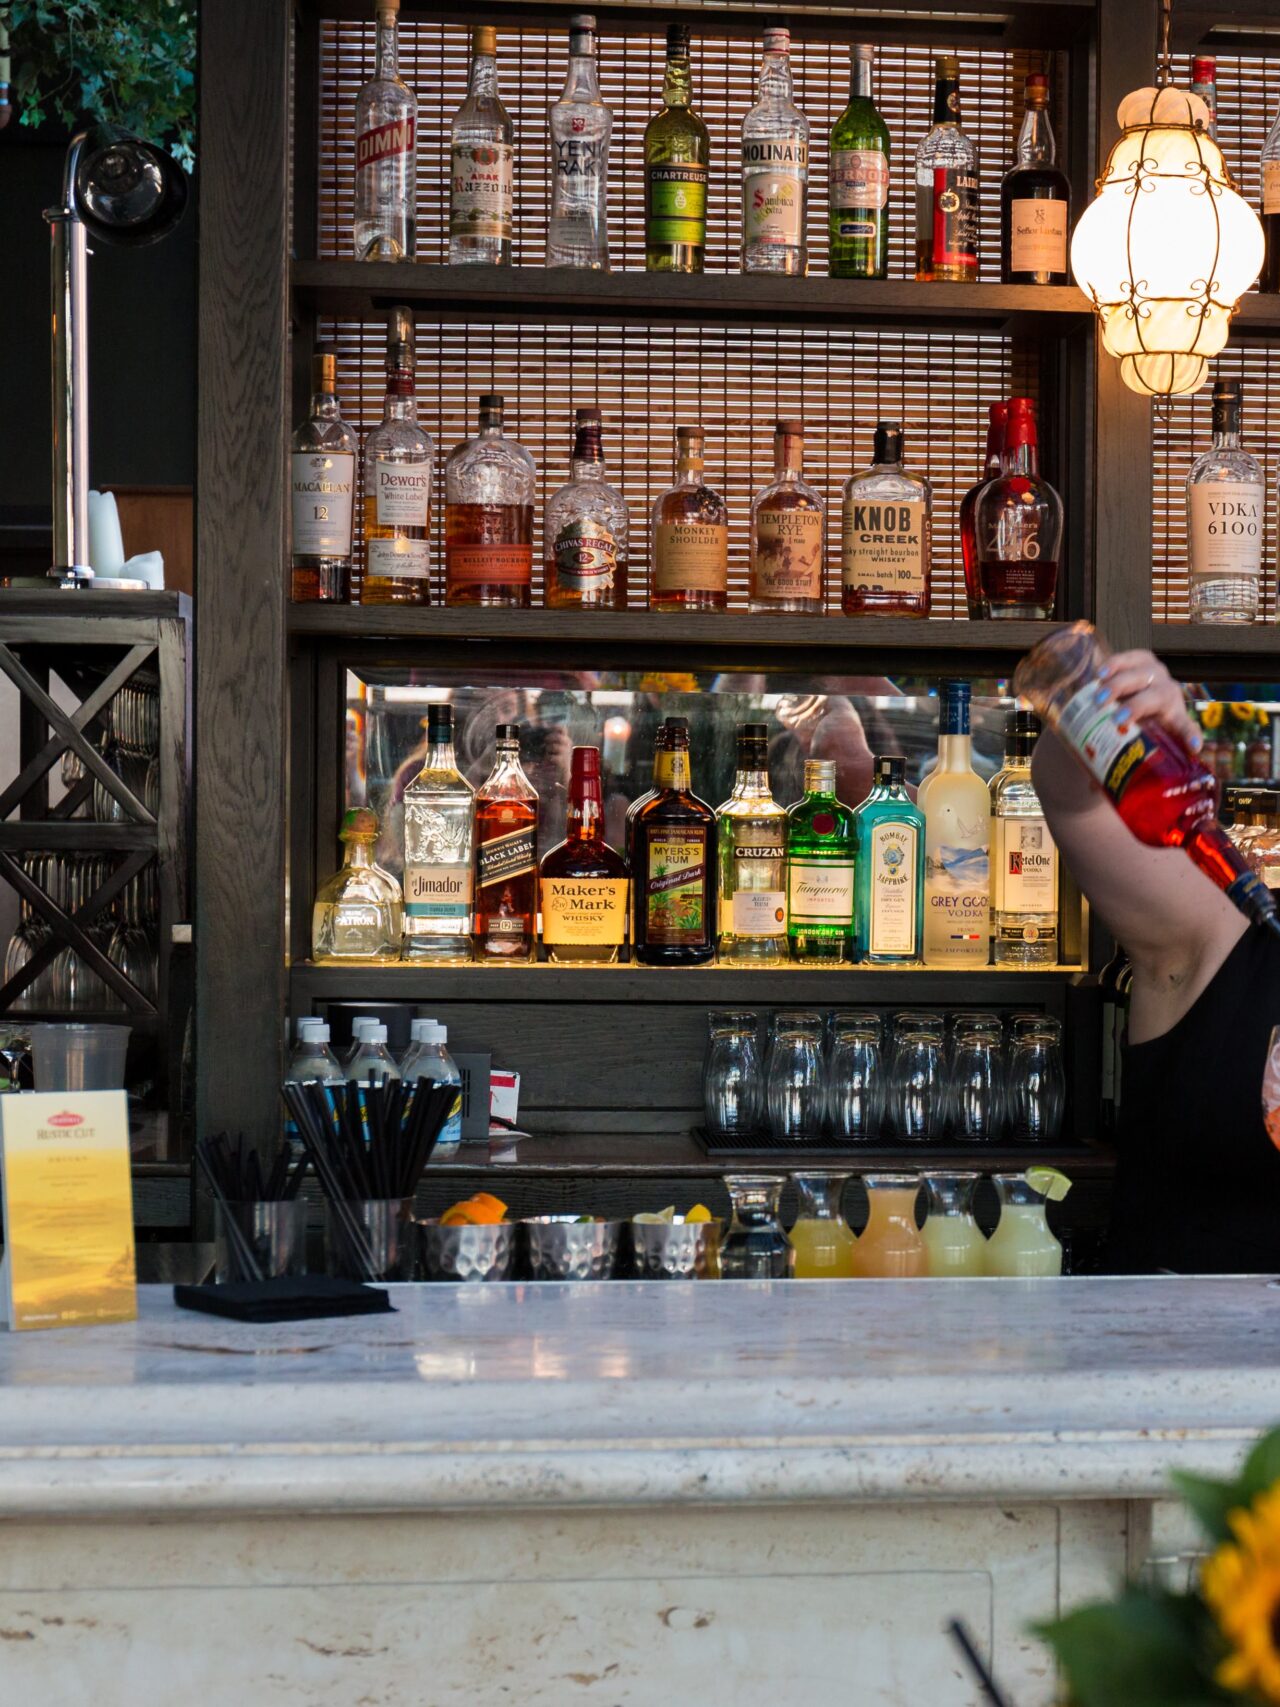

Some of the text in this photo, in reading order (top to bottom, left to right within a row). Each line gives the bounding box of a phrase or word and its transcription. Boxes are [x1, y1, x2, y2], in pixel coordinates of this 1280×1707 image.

[358, 123, 414, 160] DIMMI
[555, 140, 596, 157] YEN
[743, 144, 805, 163] MOLINARI
[557, 160, 596, 176] RAK
[470, 173, 499, 181] ARAK
[651, 171, 707, 182] CHARTREUSE
[831, 169, 888, 182] PERNOD
[380, 473, 427, 487] Dewar's
[294, 482, 350, 493] MACALLAN
[313, 506, 329, 521] 12
[1208, 502, 1258, 518] VDKA
[761, 514, 819, 526] TEMPLETON
[854, 506, 911, 532] KNOB
[675, 526, 716, 535] MONKEY
[777, 525, 804, 535] RYE
[1208, 521, 1258, 536] 6100
[670, 535, 719, 545] SHOULDER
[860, 534, 919, 544] CREEK
[555, 538, 614, 553] CHIVAS REGAL
[859, 547, 888, 557] straight
[890, 547, 919, 556] bourbon
[898, 570, 912, 579] 100
[879, 832, 908, 845] BOMBAY
[481, 842, 535, 866] BLACK LABEL
[654, 847, 699, 855] MYERS'S
[735, 847, 784, 857] CRUZAN
[665, 855, 689, 864] RUM
[1009, 852, 1050, 874] Ketel One
[650, 868, 702, 890] Original Dark
[877, 873, 910, 886] SAPPHIRE
[414, 876, 463, 897] Jimador
[551, 885, 616, 896] Maker's
[796, 881, 849, 896] Tanqueray
[570, 899, 615, 910] Mark
[931, 896, 959, 908] GREY
[948, 909, 984, 918] VODKA
[36, 1128, 95, 1140] RUSTIC CUT
